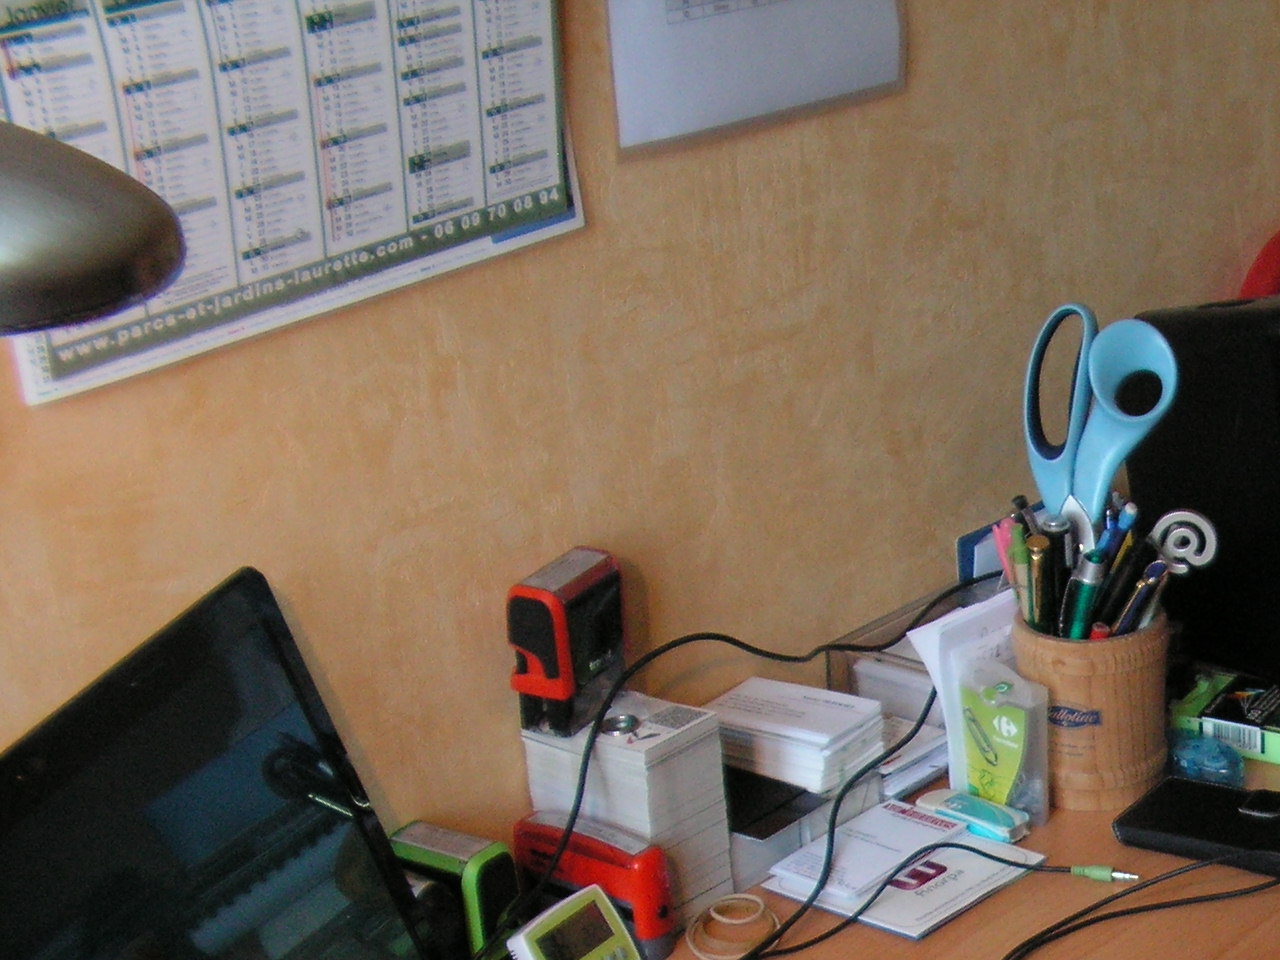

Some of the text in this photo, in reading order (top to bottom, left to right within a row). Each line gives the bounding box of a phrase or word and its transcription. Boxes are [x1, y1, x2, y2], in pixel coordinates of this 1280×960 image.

[432, 220, 455, 239] 06
[459, 211, 481, 230] 09
[486, 203, 507, 221] 70
[511, 195, 533, 213] 08
[537, 186, 559, 205] 94
